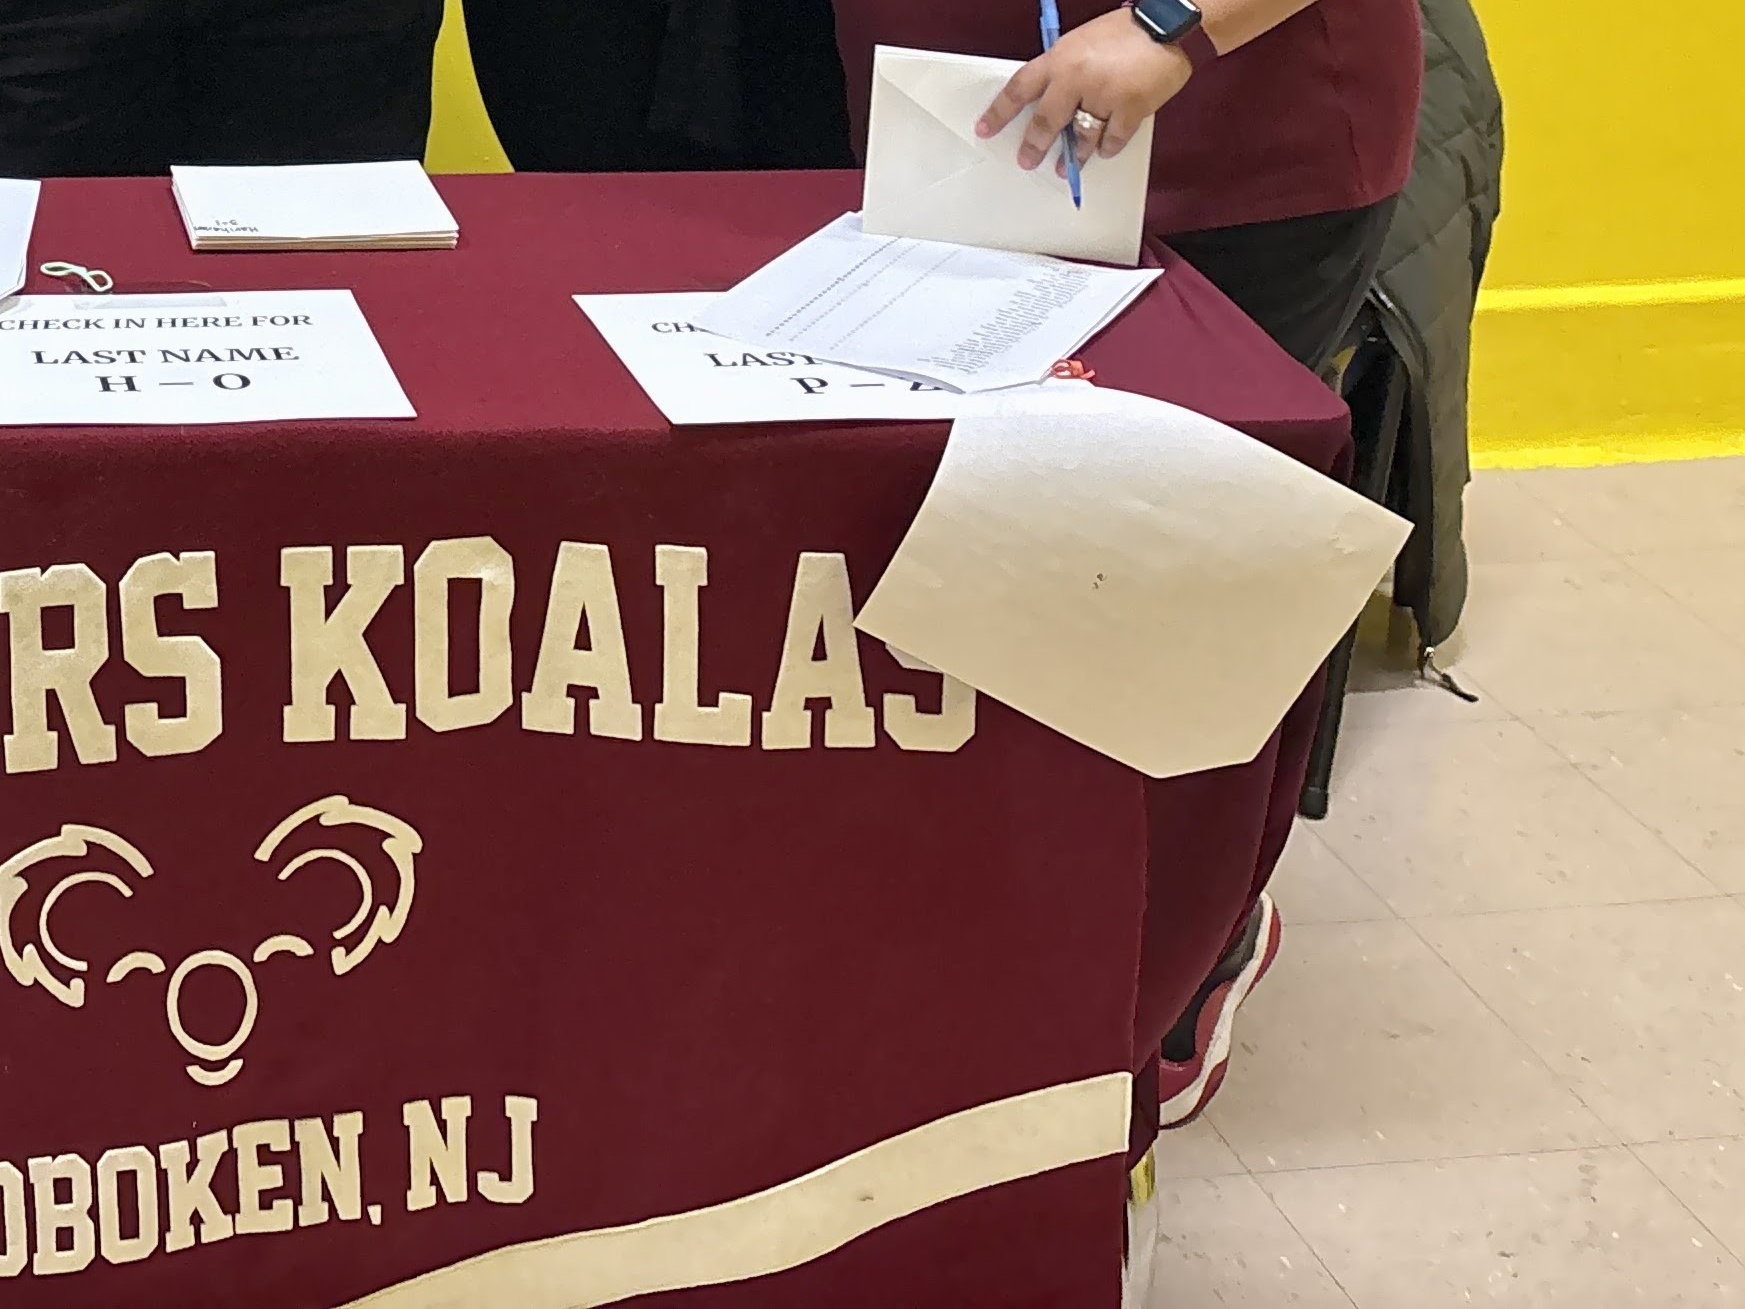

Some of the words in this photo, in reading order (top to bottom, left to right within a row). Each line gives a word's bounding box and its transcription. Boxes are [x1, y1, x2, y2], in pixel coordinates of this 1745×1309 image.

[112, 317, 147, 330] IN
[155, 315, 244, 329] HERE
[251, 314, 315, 327] FOR
[31, 349, 148, 365] LAST
[157, 346, 300, 363] NAME
[705, 352, 824, 368] LAST
[94, 375, 143, 393] H
[211, 373, 252, 391] O
[789, 377, 829, 395] P
[402, 1095, 539, 1212] NJ
